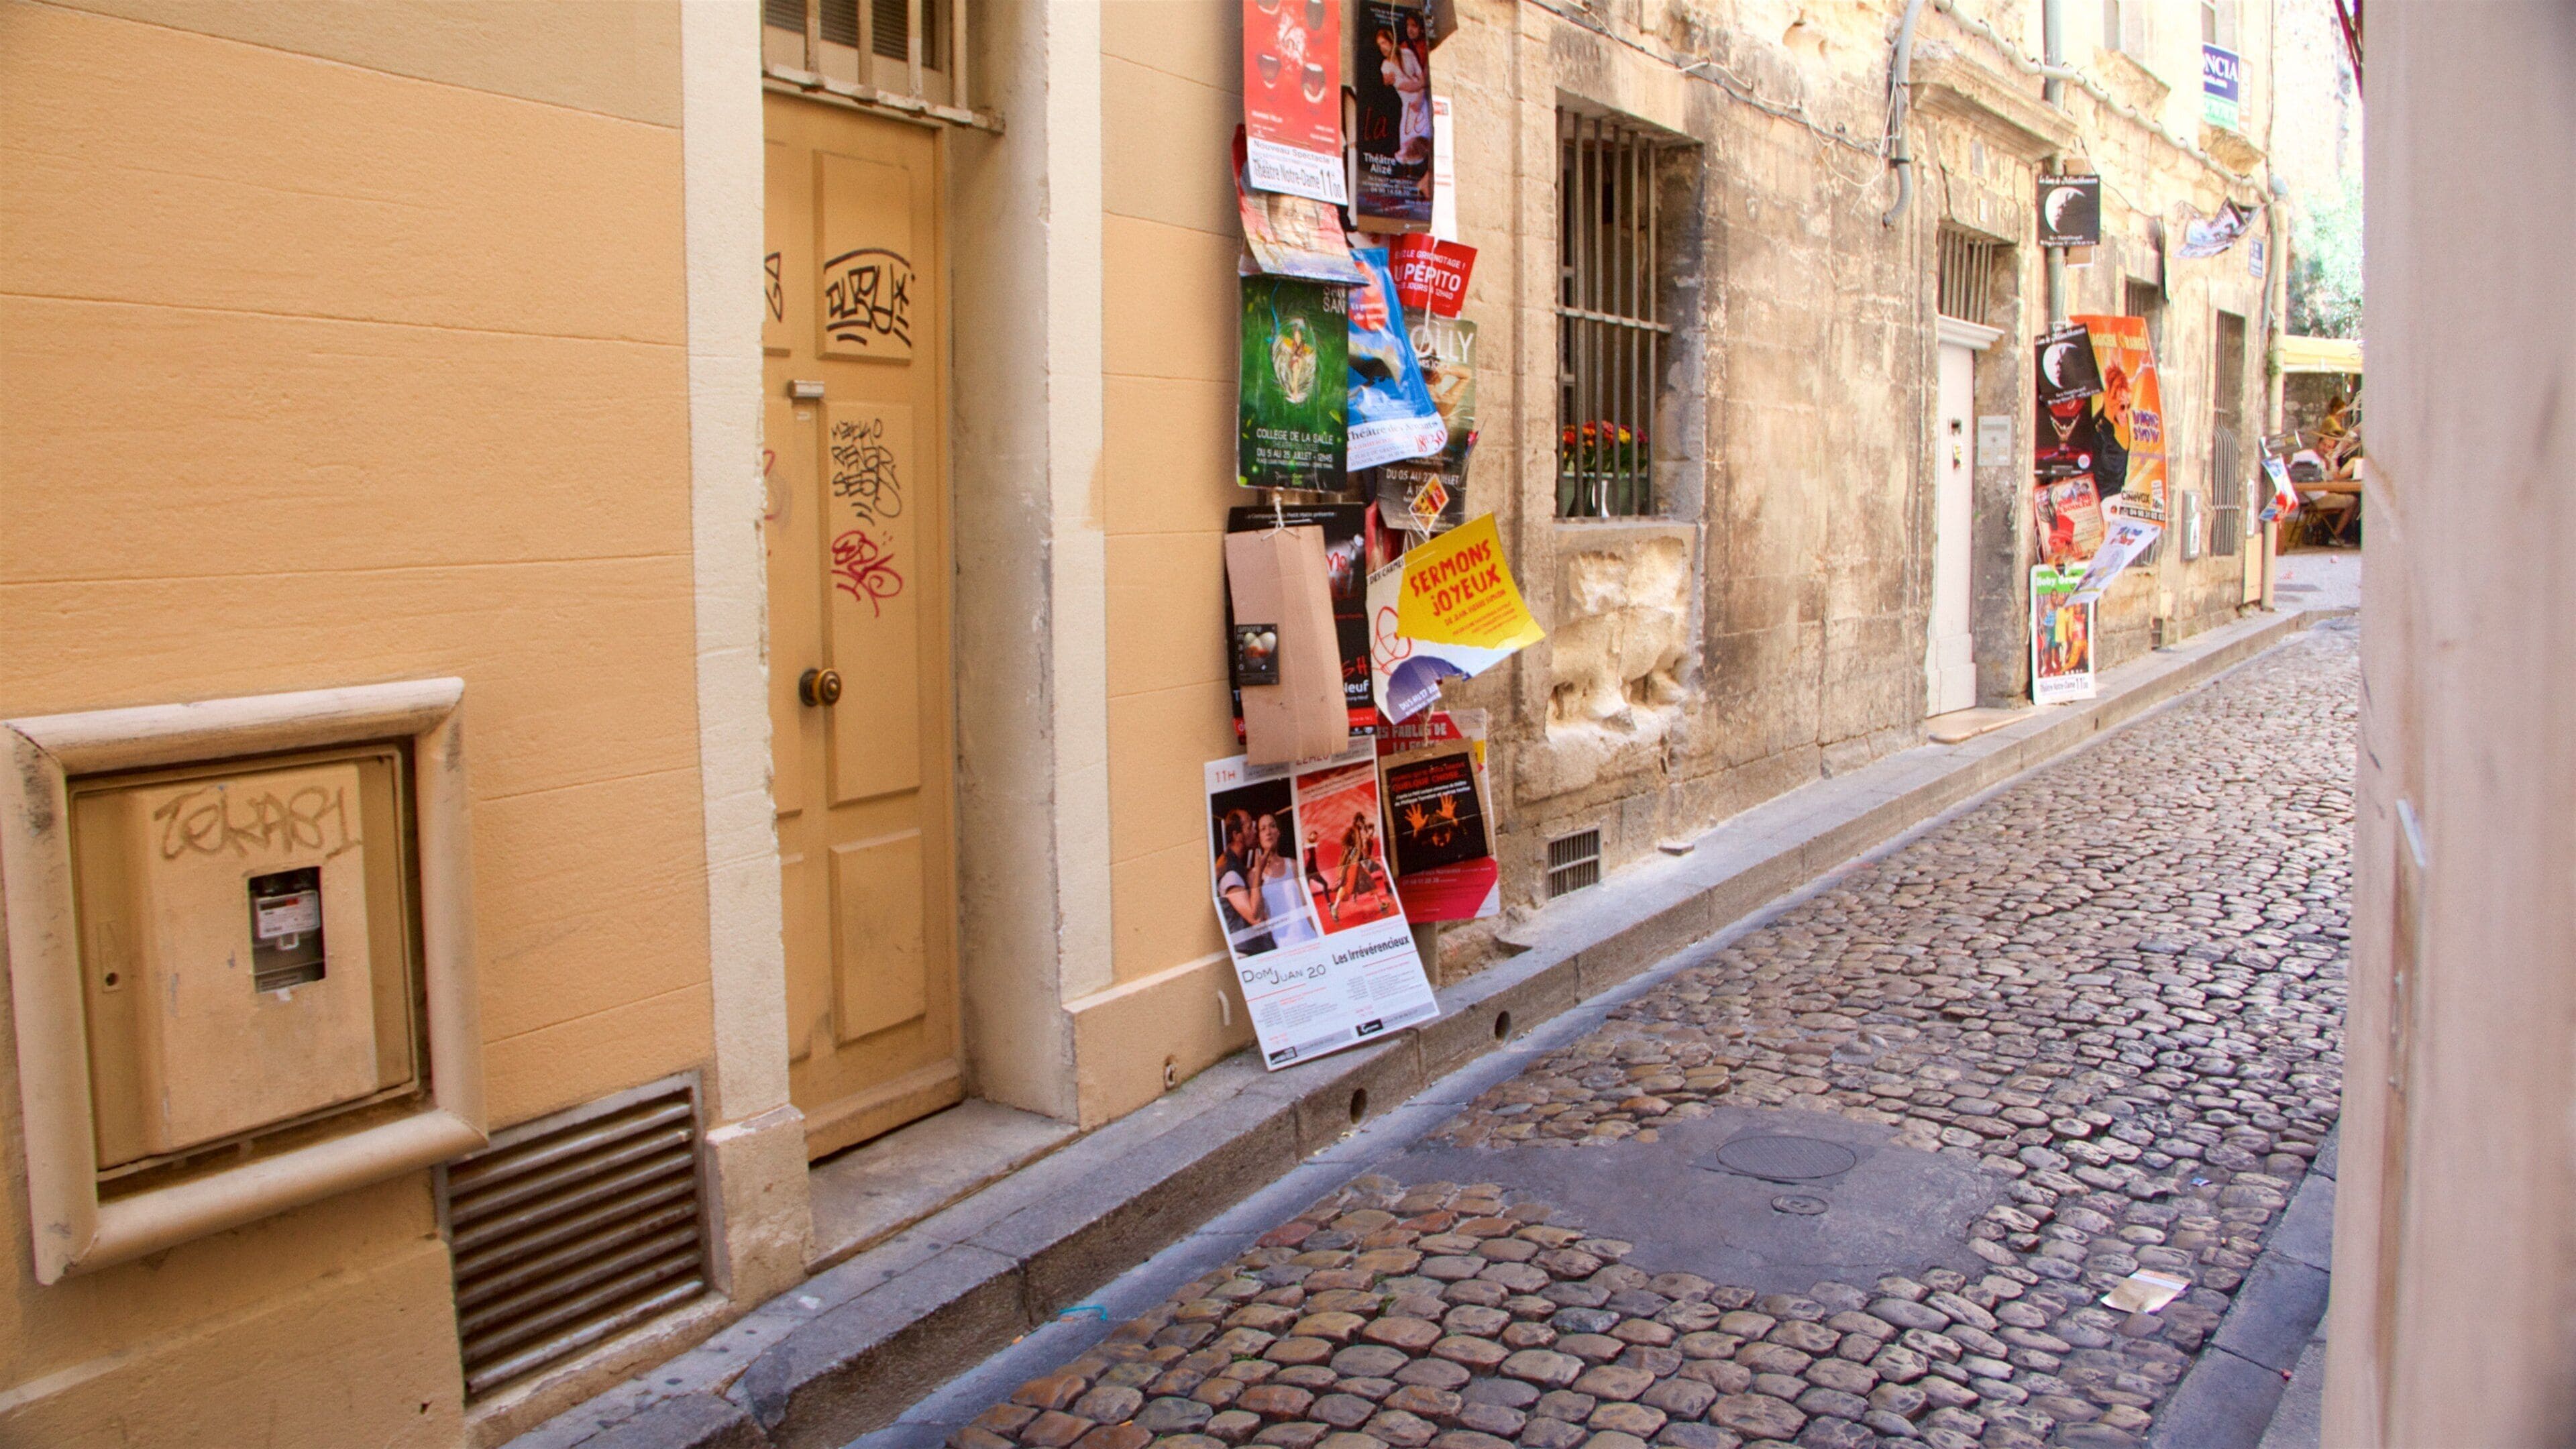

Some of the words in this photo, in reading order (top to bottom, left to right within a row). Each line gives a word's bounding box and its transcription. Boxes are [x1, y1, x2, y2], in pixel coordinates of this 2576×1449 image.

[1253, 139, 1290, 155] Nouveau
[1291, 148, 1331, 165] Spectacle
[1363, 152, 1397, 166] Théâtre
[1370, 163, 1393, 175] Alizé
[1404, 260, 1462, 292] PÉPITO
[1256, 427, 1288, 441] COLLEGE
[1289, 430, 1300, 441] DE
[1301, 432, 1311, 443] LA
[1312, 433, 1334, 445] SALLE
[1256, 447, 1266, 458] DU
[1267, 448, 1272, 458] 5
[1273, 449, 1282, 459] AU
[1386, 468, 1397, 480] DU
[1409, 470, 1421, 482] AU
[1409, 538, 1491, 598] SERMONS
[1332, 953, 1348, 966] Les
[1350, 935, 1410, 962] Irrévérencieux
